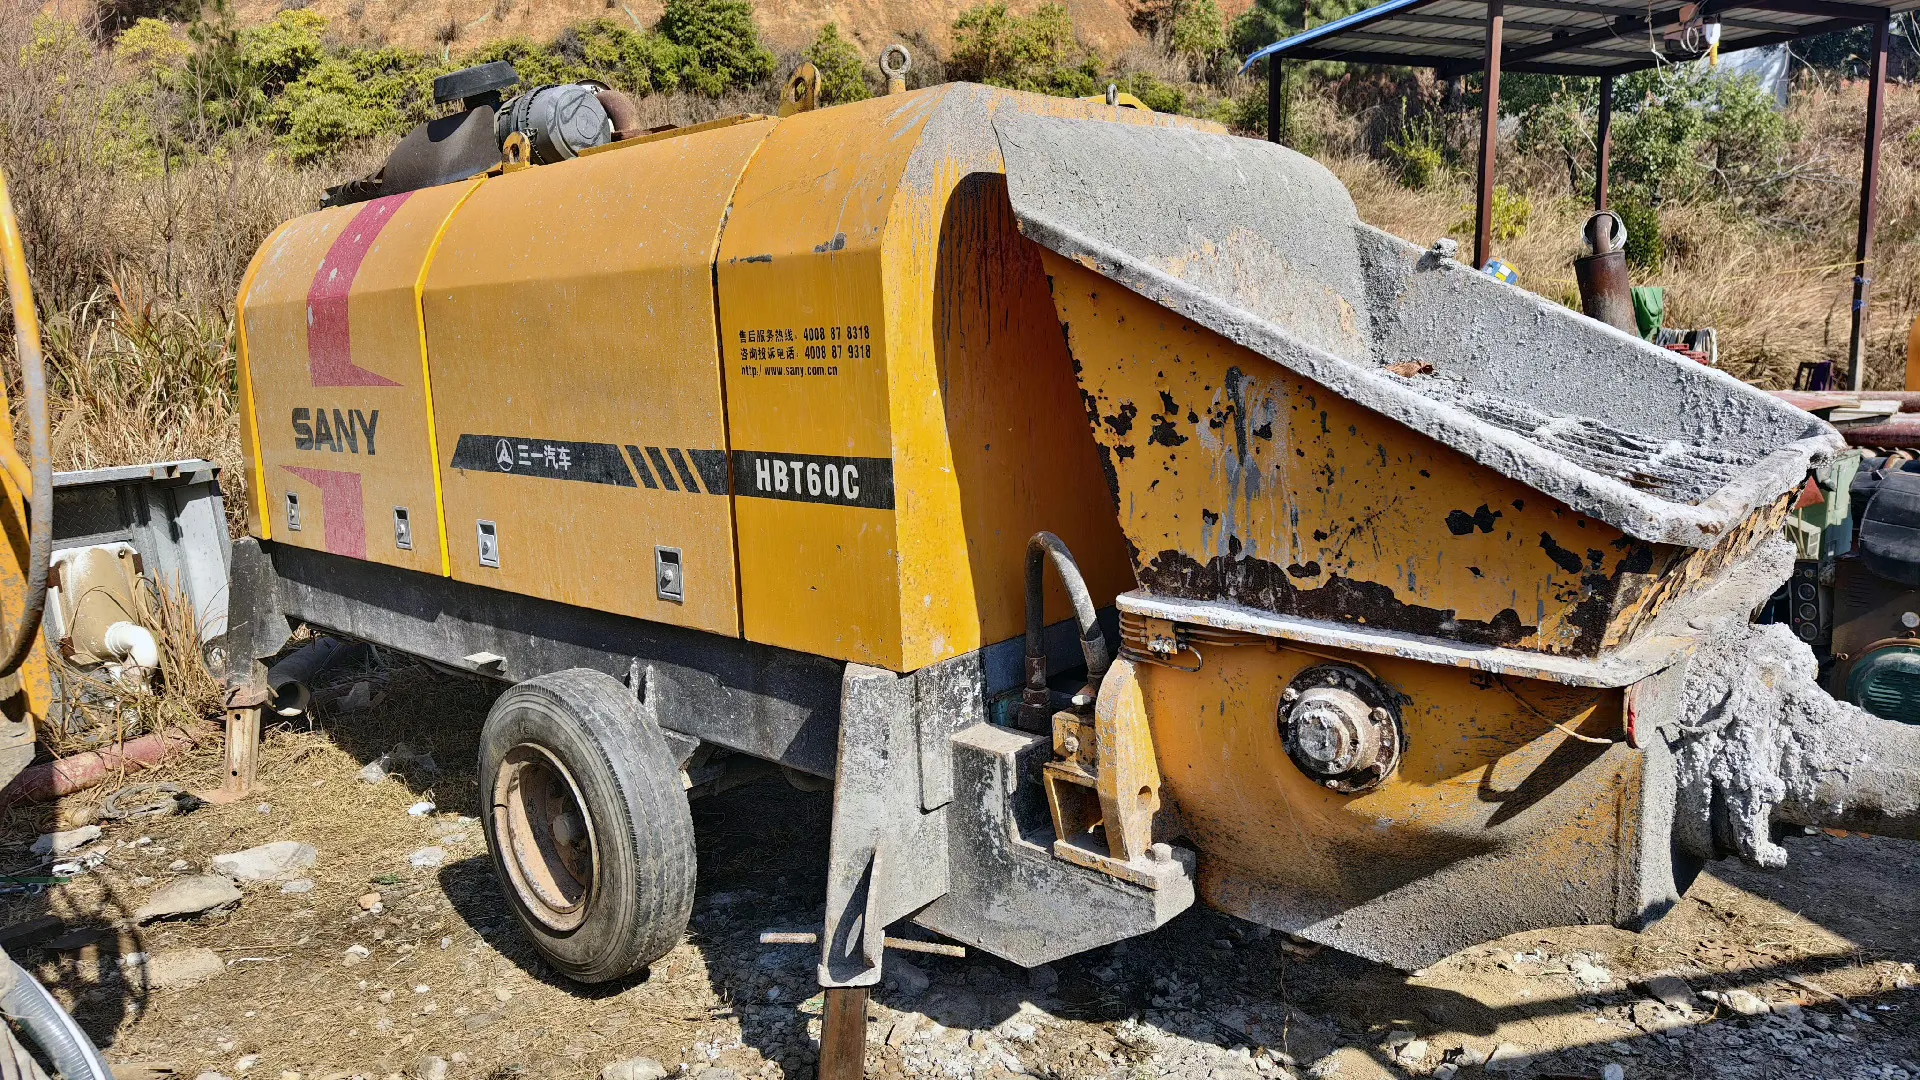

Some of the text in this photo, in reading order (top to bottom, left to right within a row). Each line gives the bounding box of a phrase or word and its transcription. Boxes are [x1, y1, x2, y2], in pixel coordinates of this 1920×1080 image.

[803, 327, 825, 341] 4008
[830, 327, 841, 340] 87
[847, 325, 870, 340] 8318
[805, 345, 826, 359] 4008
[831, 344, 842, 359] 87
[847, 344, 871, 359] 9318
[291, 407, 379, 456] SANY
[517, 444, 572, 471] 三一汽车
[755, 458, 860, 500] HBT60C
